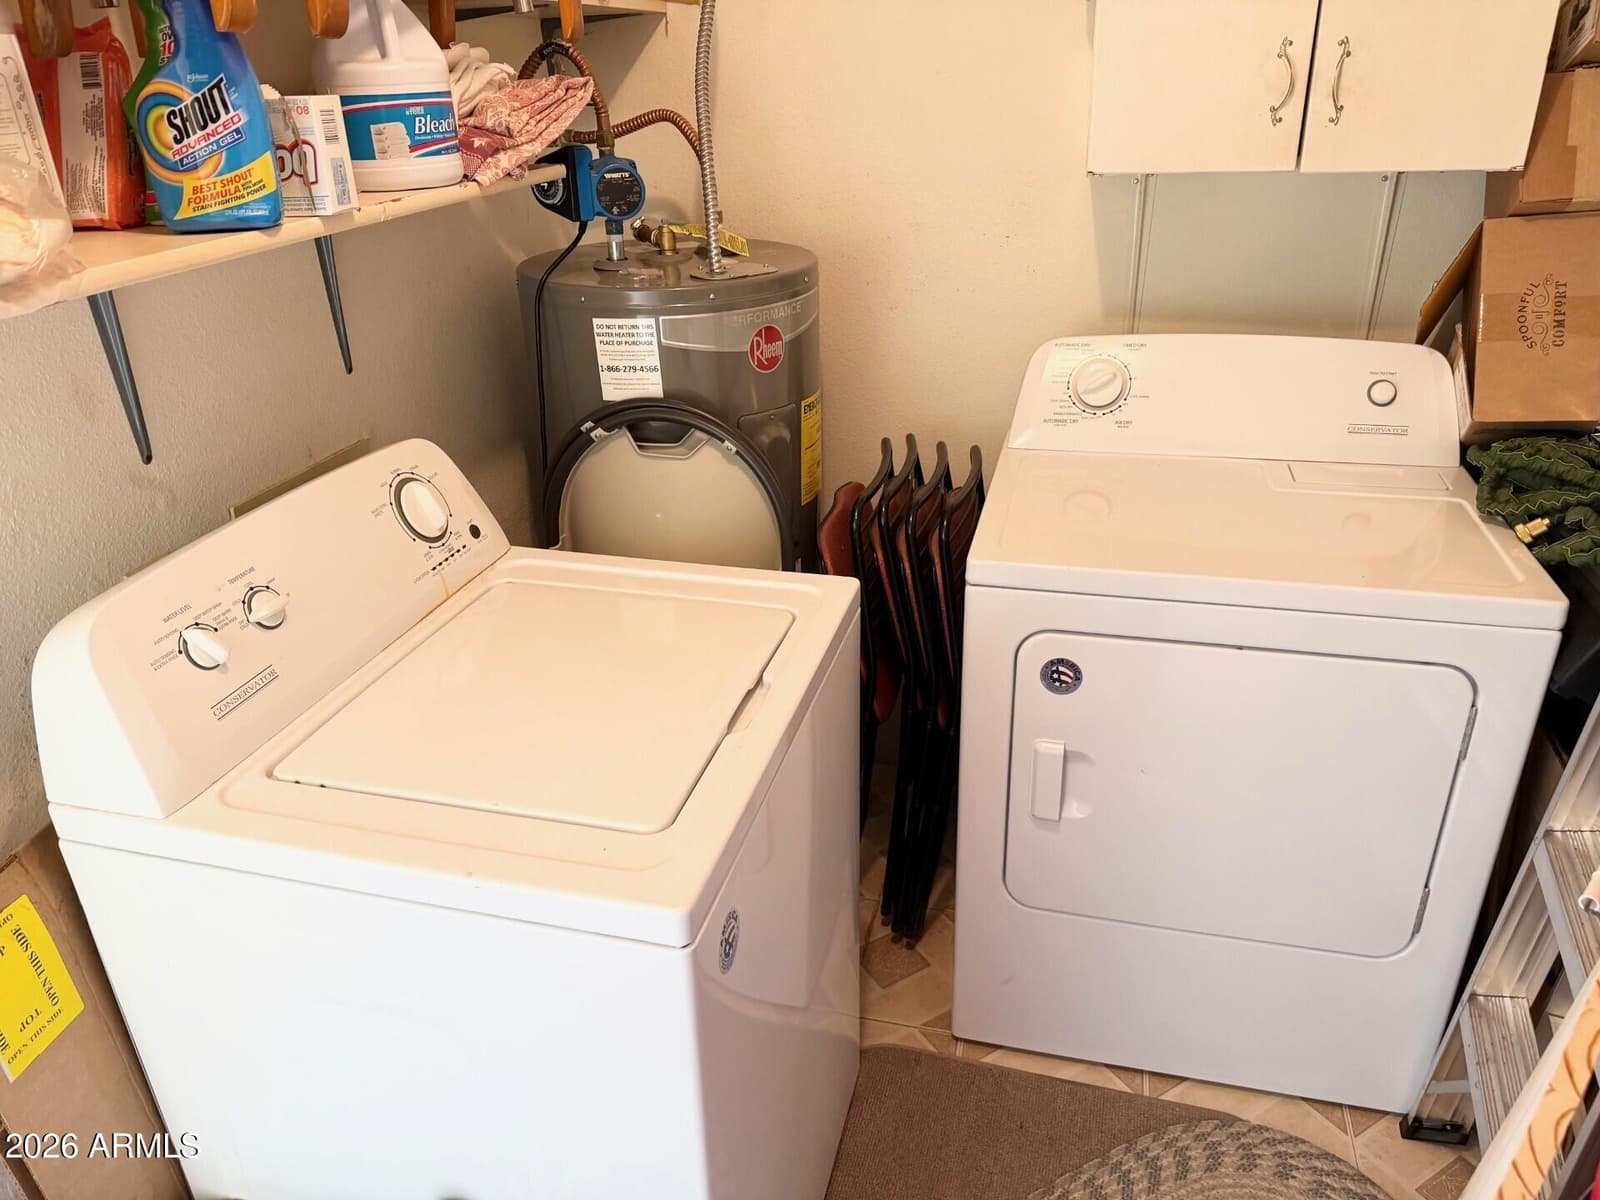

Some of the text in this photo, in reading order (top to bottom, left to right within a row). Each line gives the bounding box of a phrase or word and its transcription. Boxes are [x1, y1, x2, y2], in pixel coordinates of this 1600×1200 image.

[166, 77, 233, 145] SHOUT
[415, 113, 455, 134] Bleach
[172, 113, 242, 159] ADVANCED
[183, 130, 242, 165] ACTION GEL
[187, 185, 241, 207] FORMULA
[192, 169, 254, 195] BEST SHOUT
[192, 202, 213, 213] STAIN
[214, 193, 245, 209] FIGHTING
[246, 184, 266, 198] POWER
[736, 301, 801, 325] RFORMANCE
[1517, 282, 1540, 349] SPOONFUL
[1552, 280, 1567, 347] COMFORT
[753, 327, 783, 365] Rheem
[600, 365, 659, 373] 1-866-279-4566
[162, 604, 192, 623] WATER LEVEL
[212, 668, 278, 717] CONSERVATOR
[10, 924, 60, 1007] OPEN THIS SIDE
[8, 1006, 64, 1065] OPEN THIS SIDE
[19, 1007, 42, 1033] TOP
